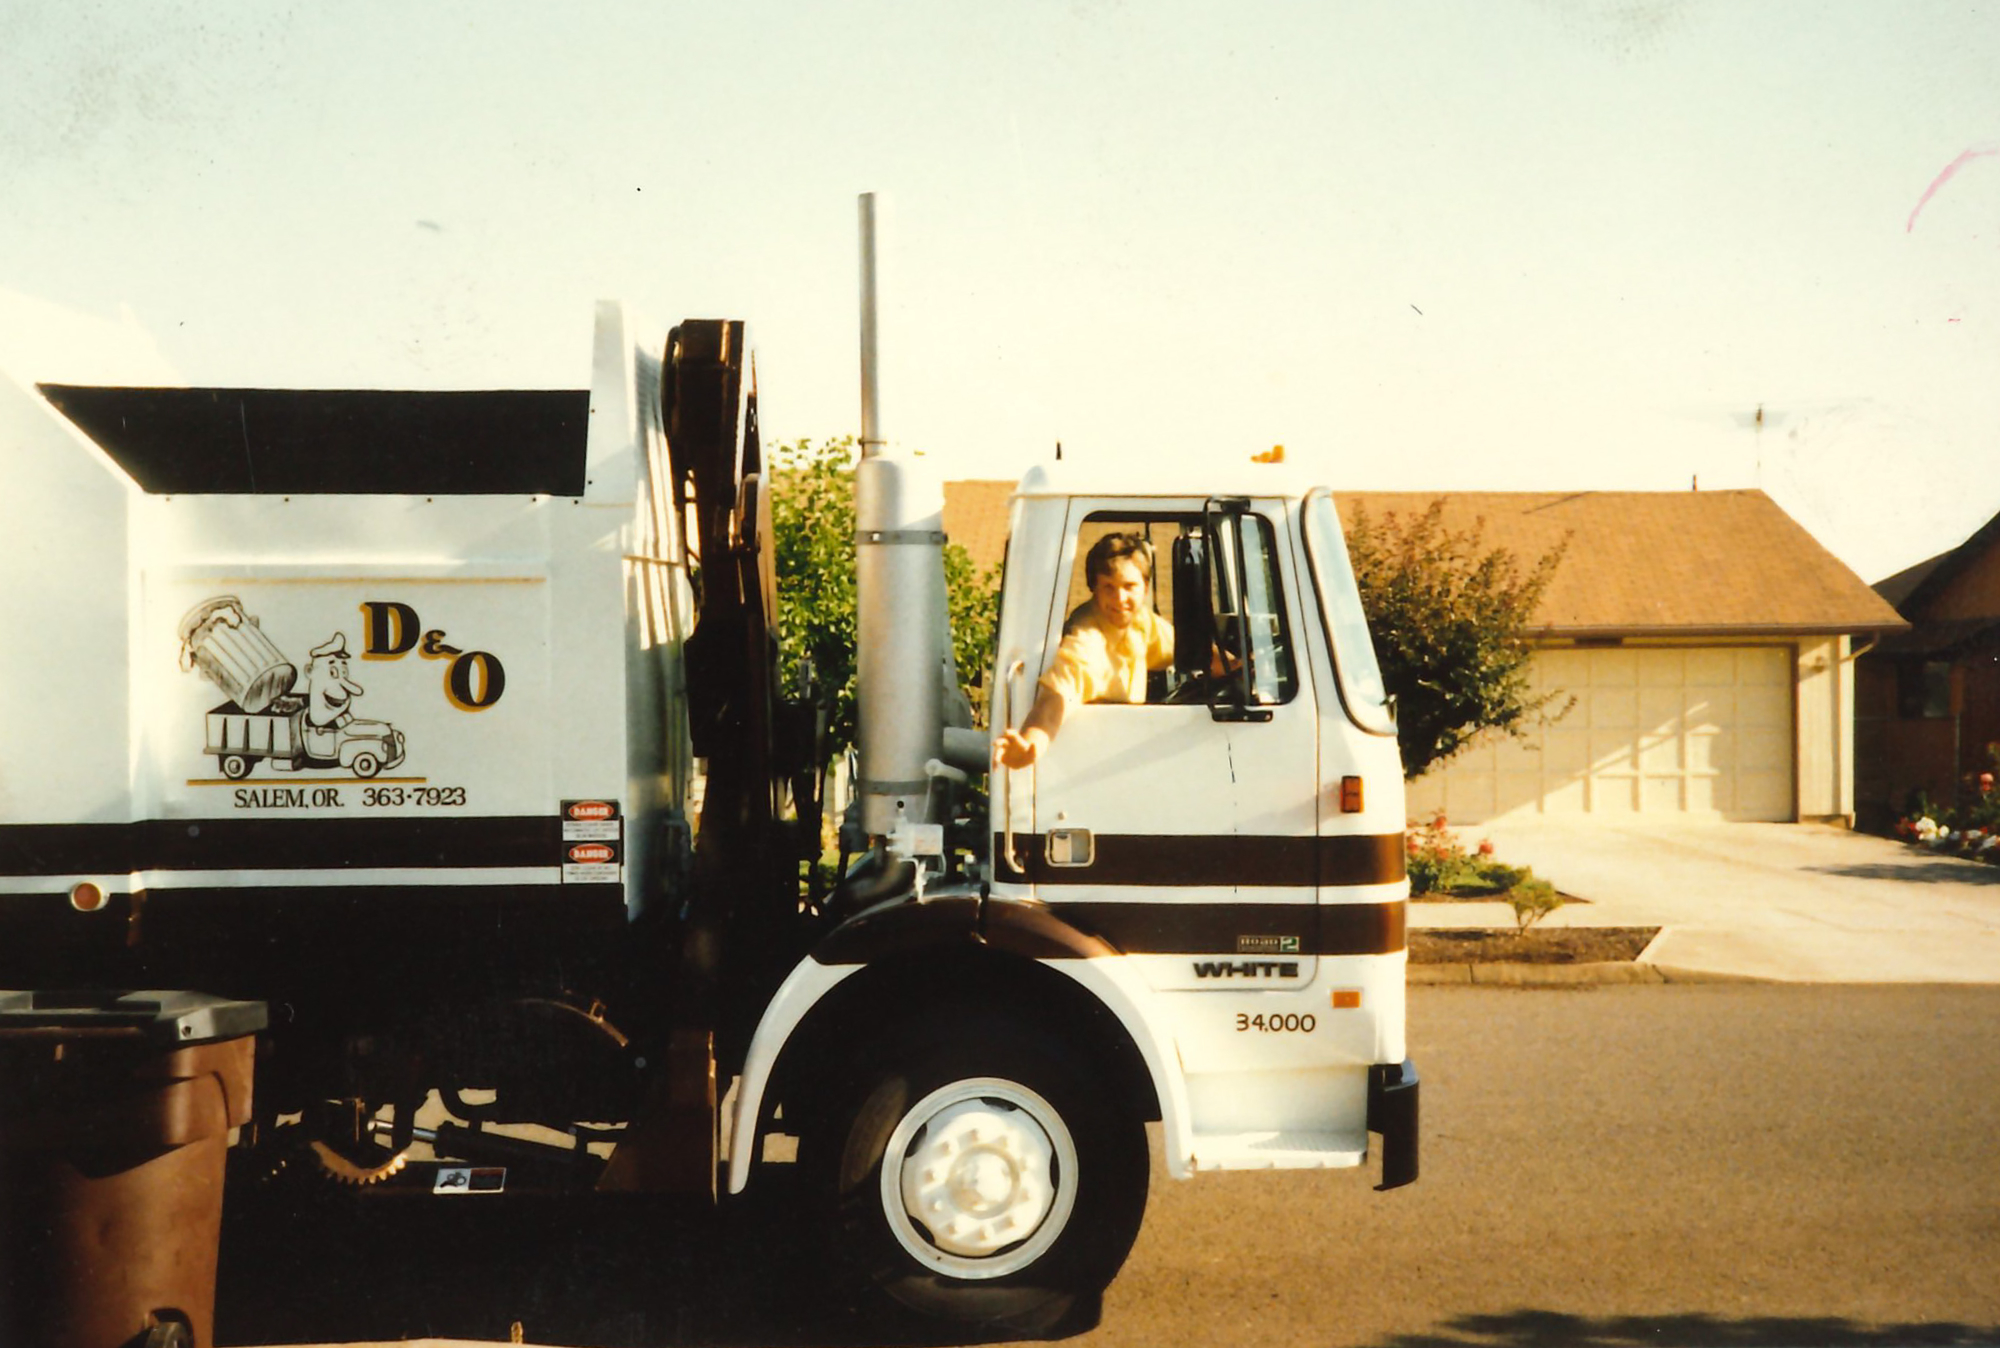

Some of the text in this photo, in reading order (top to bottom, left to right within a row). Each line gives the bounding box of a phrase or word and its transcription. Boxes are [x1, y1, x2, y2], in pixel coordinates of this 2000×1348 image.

[234, 788, 309, 809] SALEM,
[312, 788, 345, 808] OR.
[573, 806, 609, 817] DANGER
[573, 849, 609, 859] DANGER
[1193, 961, 1299, 978] WHITE
